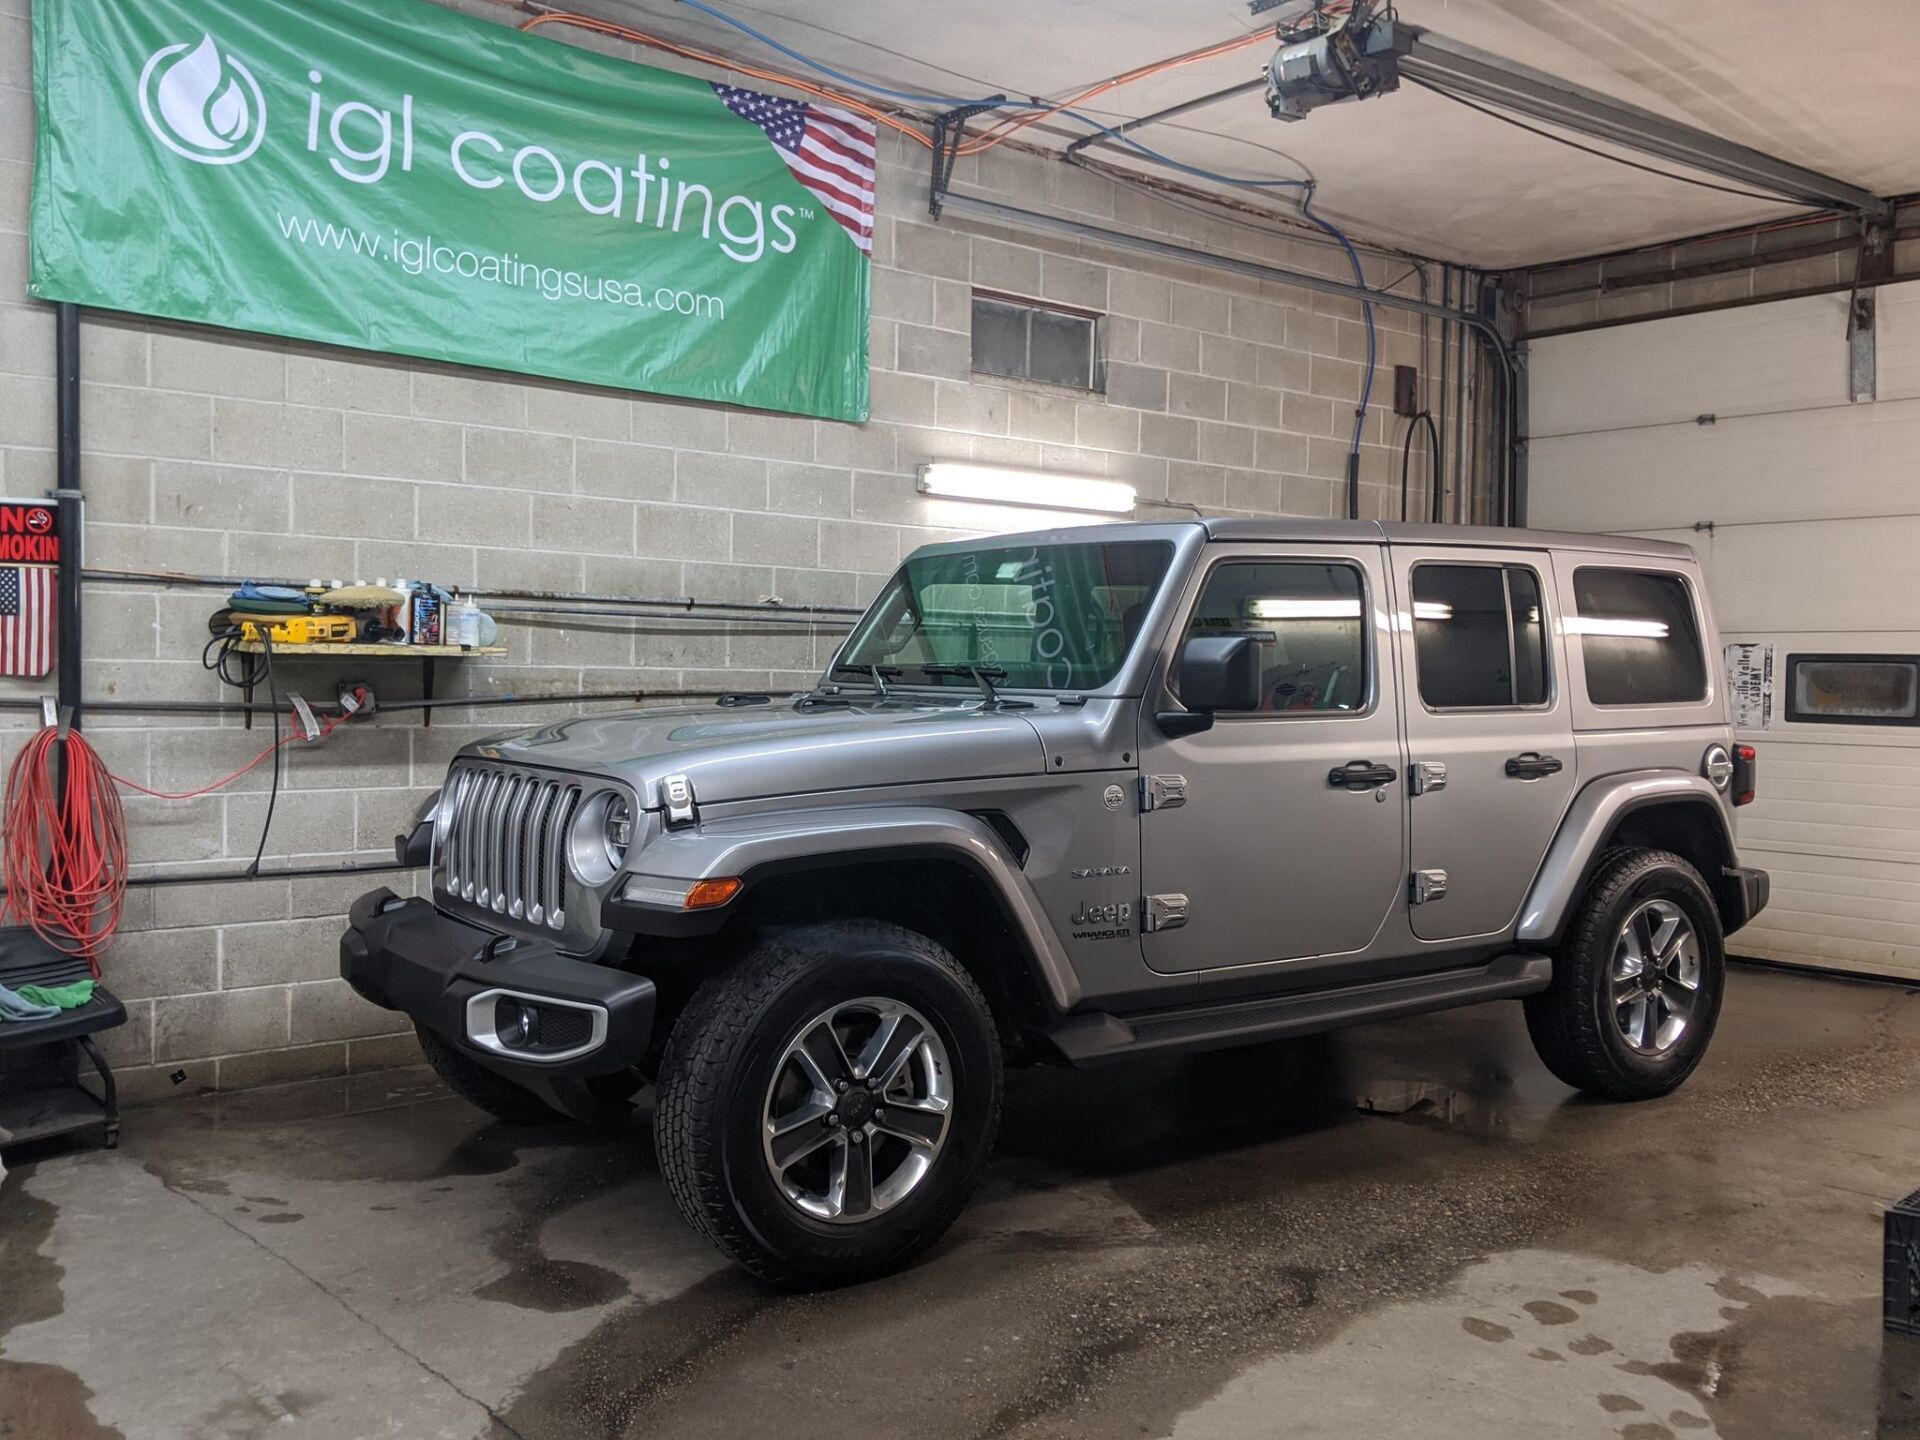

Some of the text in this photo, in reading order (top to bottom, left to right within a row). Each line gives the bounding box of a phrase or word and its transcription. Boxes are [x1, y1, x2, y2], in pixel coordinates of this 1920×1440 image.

[307, 70, 413, 184] igl
[451, 131, 797, 263] coatings
[277, 212, 724, 320] www.iglcoatingsusa.com
[1737, 649, 1753, 677] Valley
[1749, 667, 1762, 708] CADEMY
[1071, 901, 1131, 927] Jeep
[1072, 928, 1130, 940] WRANGLER
